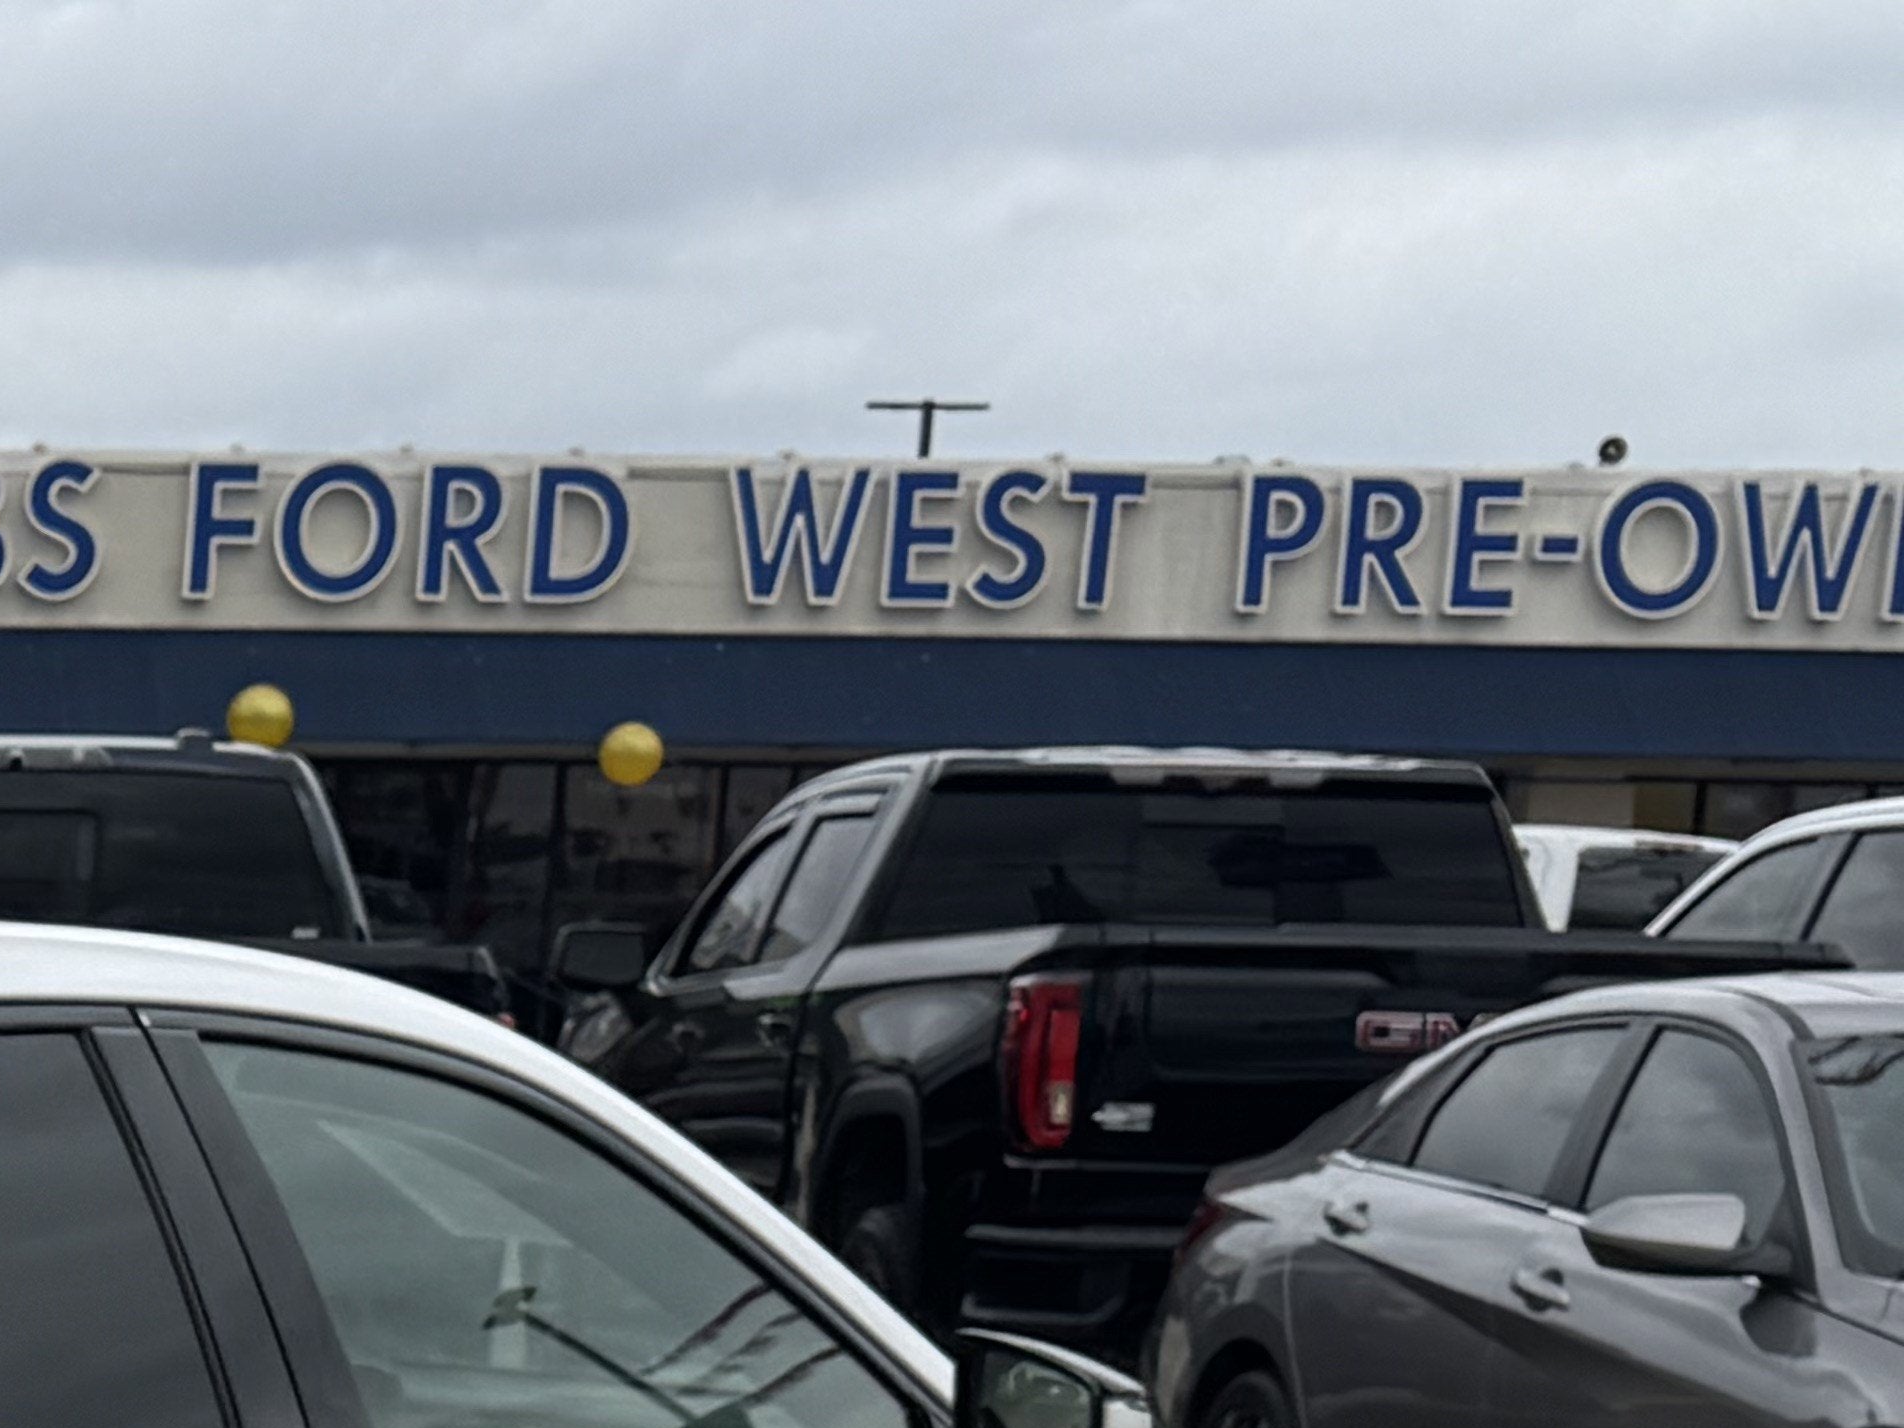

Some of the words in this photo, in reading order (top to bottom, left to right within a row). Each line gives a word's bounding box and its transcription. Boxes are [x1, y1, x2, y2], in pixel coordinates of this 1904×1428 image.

[188, 462, 630, 600] FORD
[733, 469, 1146, 604] WEST
[1241, 475, 1904, 610] PRE-OW
